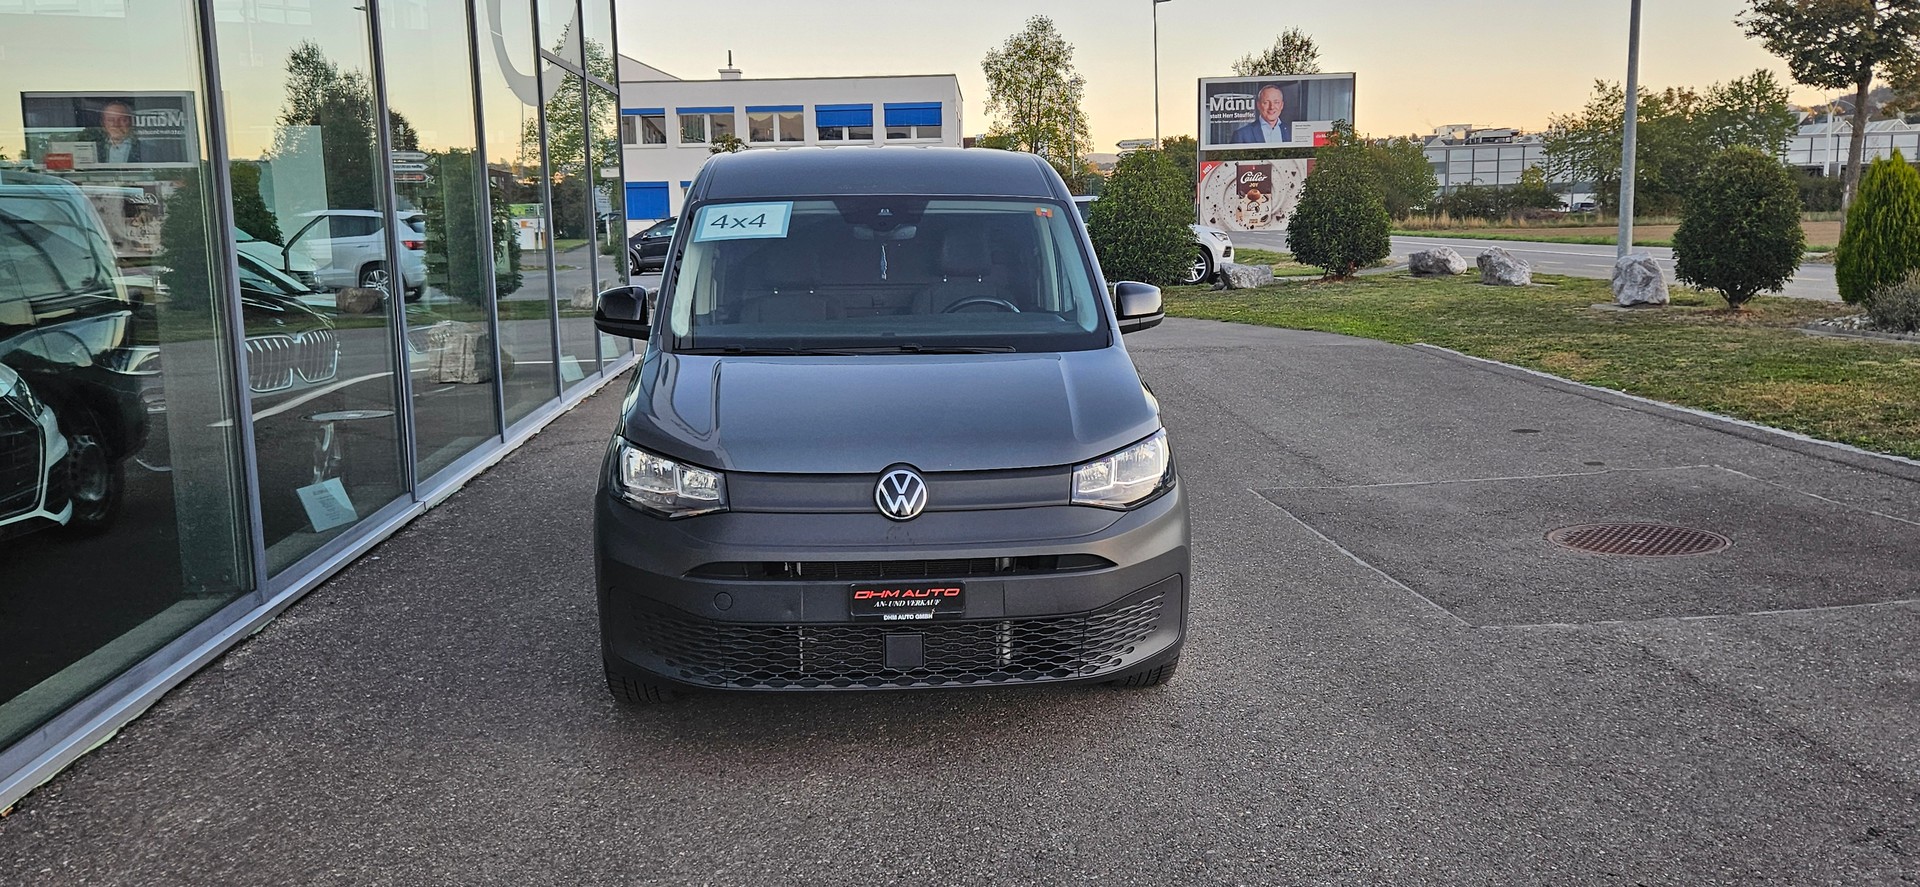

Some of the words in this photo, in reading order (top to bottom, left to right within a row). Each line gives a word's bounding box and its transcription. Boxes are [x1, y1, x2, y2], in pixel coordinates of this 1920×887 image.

[1210, 96, 1255, 111] Mänu
[1240, 171, 1267, 184] Cailler
[710, 213, 767, 229] 4x4
[877, 470, 926, 519] VW
[854, 590, 900, 599] DHM
[902, 588, 960, 598] AUTO
